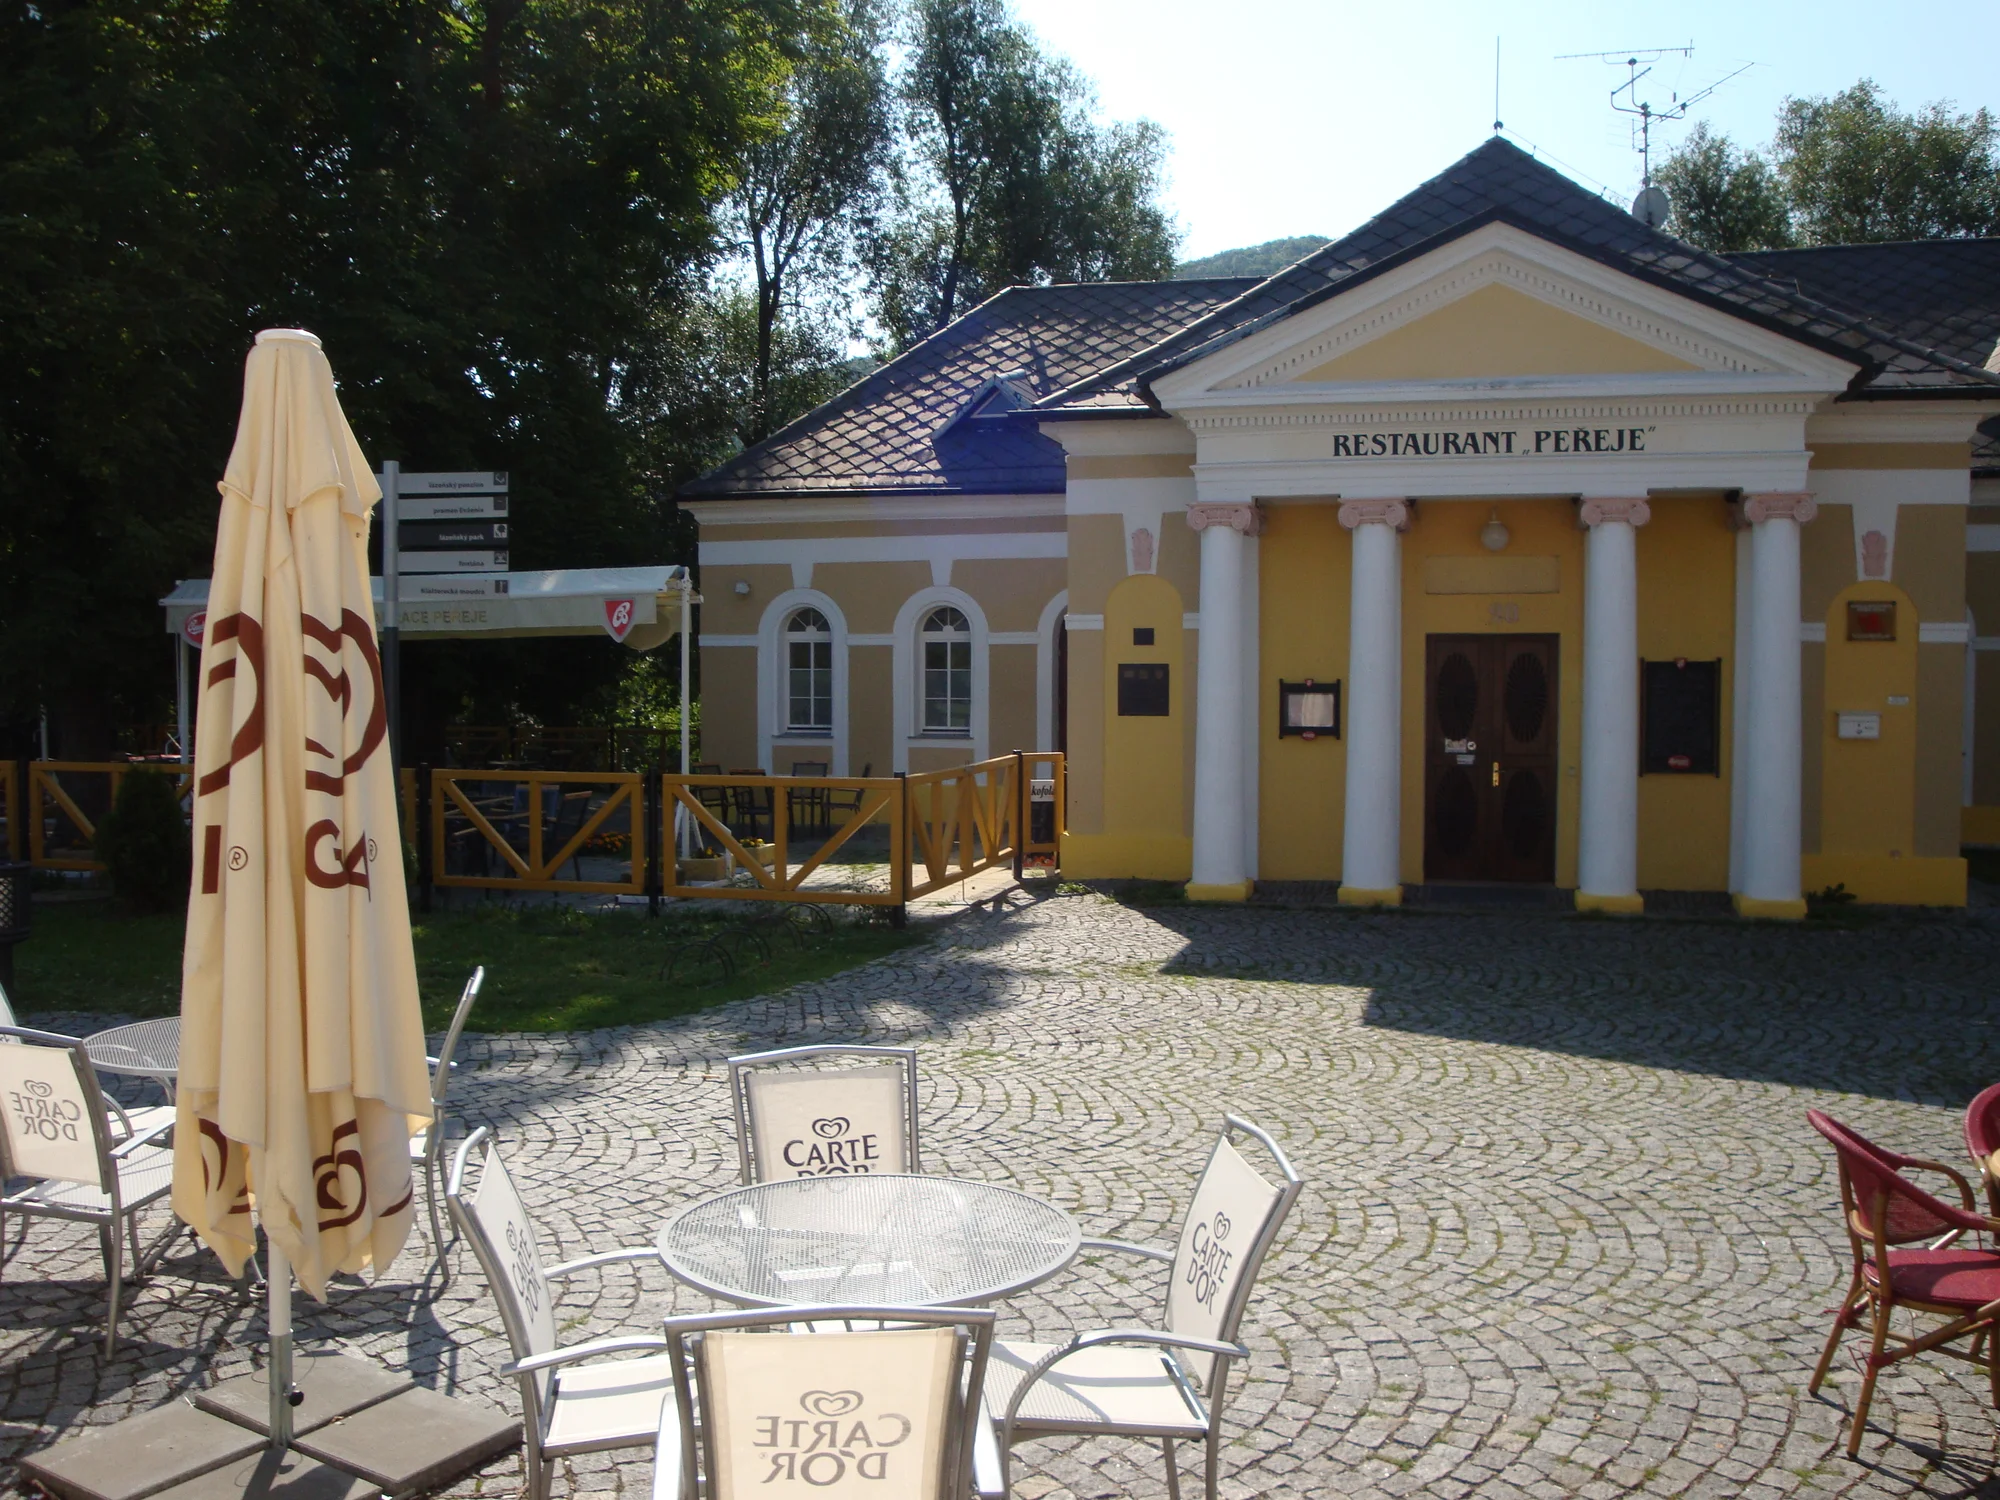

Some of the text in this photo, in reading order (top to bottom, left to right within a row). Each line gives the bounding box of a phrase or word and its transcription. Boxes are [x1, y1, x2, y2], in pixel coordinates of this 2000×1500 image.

[1333, 430, 1517, 457] RESTAURANT
[468, 534, 485, 542] park
[783, 1134, 880, 1167] CARTE
[1192, 1221, 1233, 1284] CARTE
